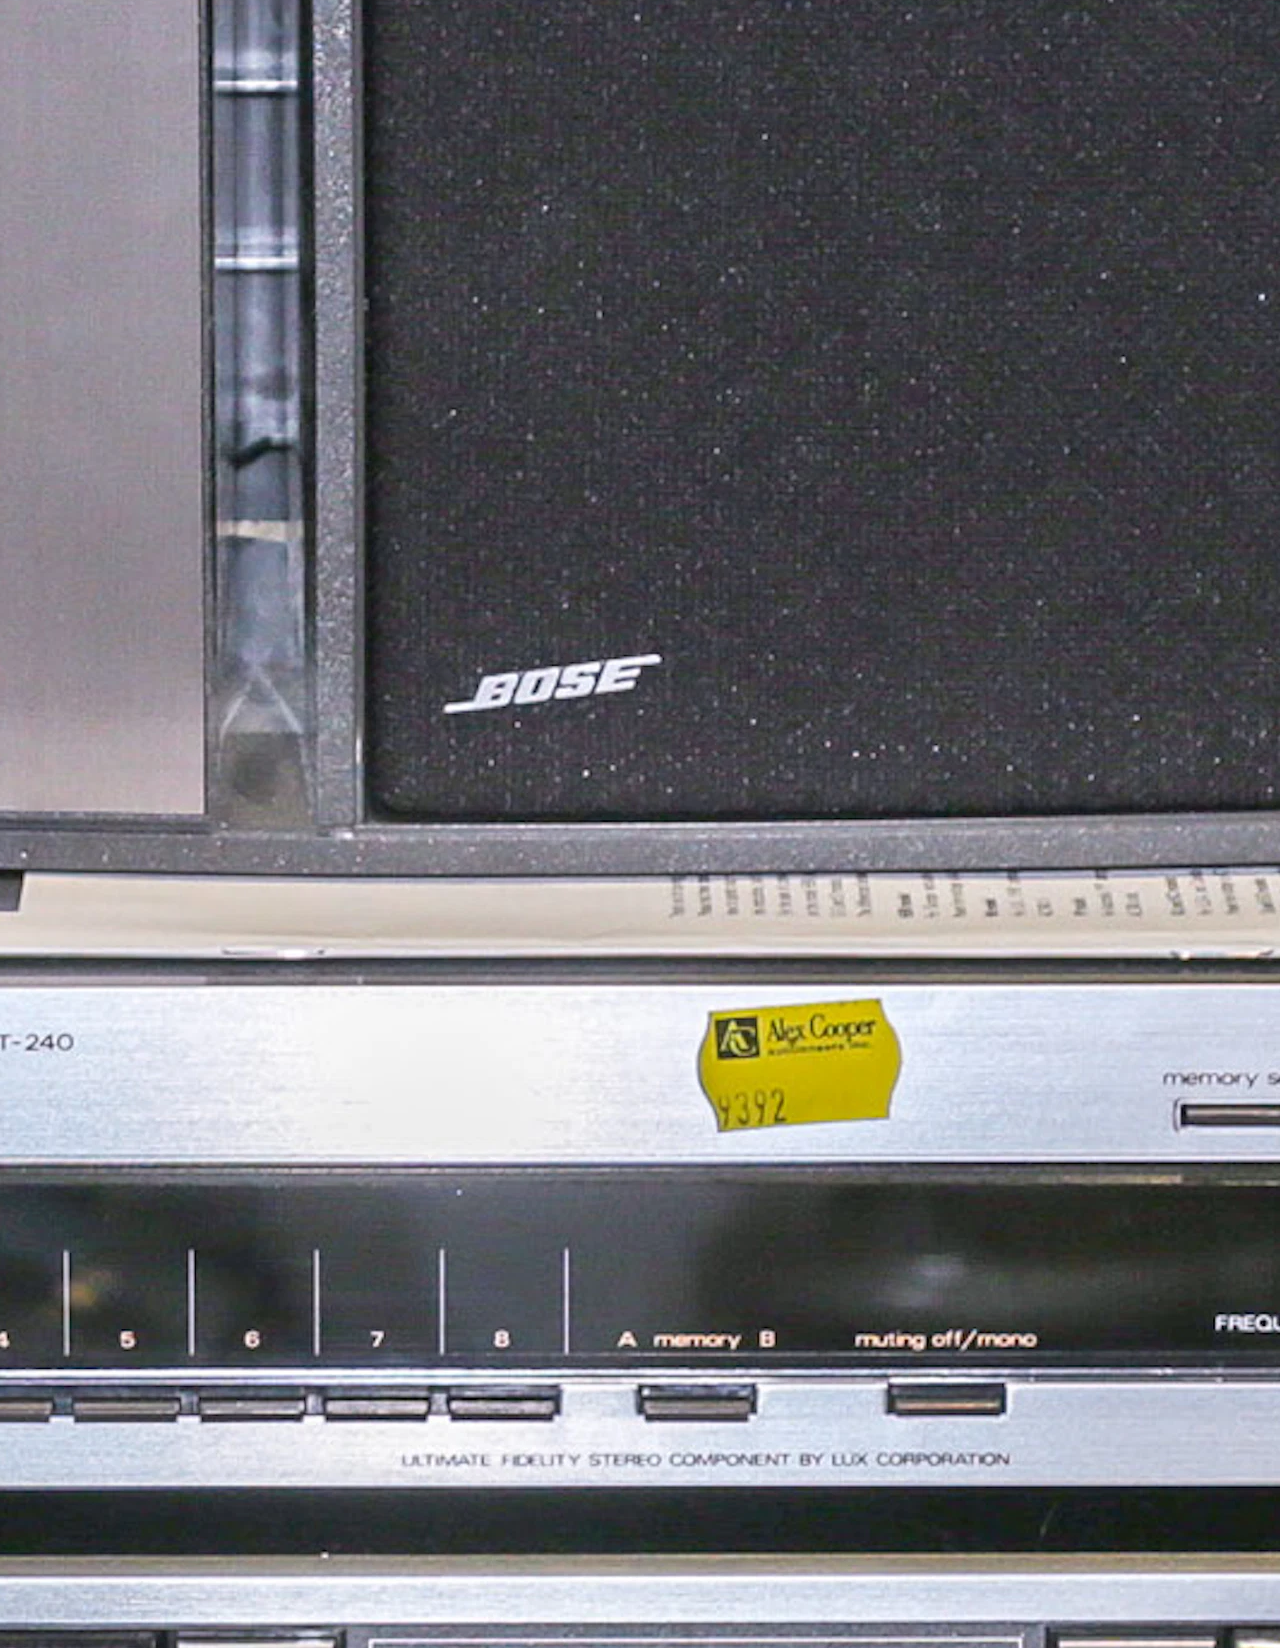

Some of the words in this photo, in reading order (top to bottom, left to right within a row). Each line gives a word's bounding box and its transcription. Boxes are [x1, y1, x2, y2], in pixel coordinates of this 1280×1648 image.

[443, 653, 662, 714] BOSE
[767, 1017, 805, 1047] Alex
[810, 1013, 876, 1042] Cooper
[1162, 1072, 1259, 1089] memory
[120, 1330, 136, 1349] 5
[244, 1330, 260, 1349] 6
[370, 1330, 385, 1348] 7
[494, 1330, 510, 1348] 8
[617, 1331, 637, 1347] A
[653, 1334, 741, 1350] memory
[759, 1330, 776, 1348] B
[855, 1333, 927, 1351] muting
[931, 1328, 1038, 1351] off/mono
[401, 1453, 490, 1468] ULTIMATE
[501, 1453, 581, 1467] FIDELITY
[588, 1453, 663, 1468] STEREO
[668, 1453, 790, 1467] COMPONENT
[799, 1453, 824, 1467] BY
[831, 1453, 868, 1467] LUX
[875, 1452, 1011, 1467] CORPORATION
